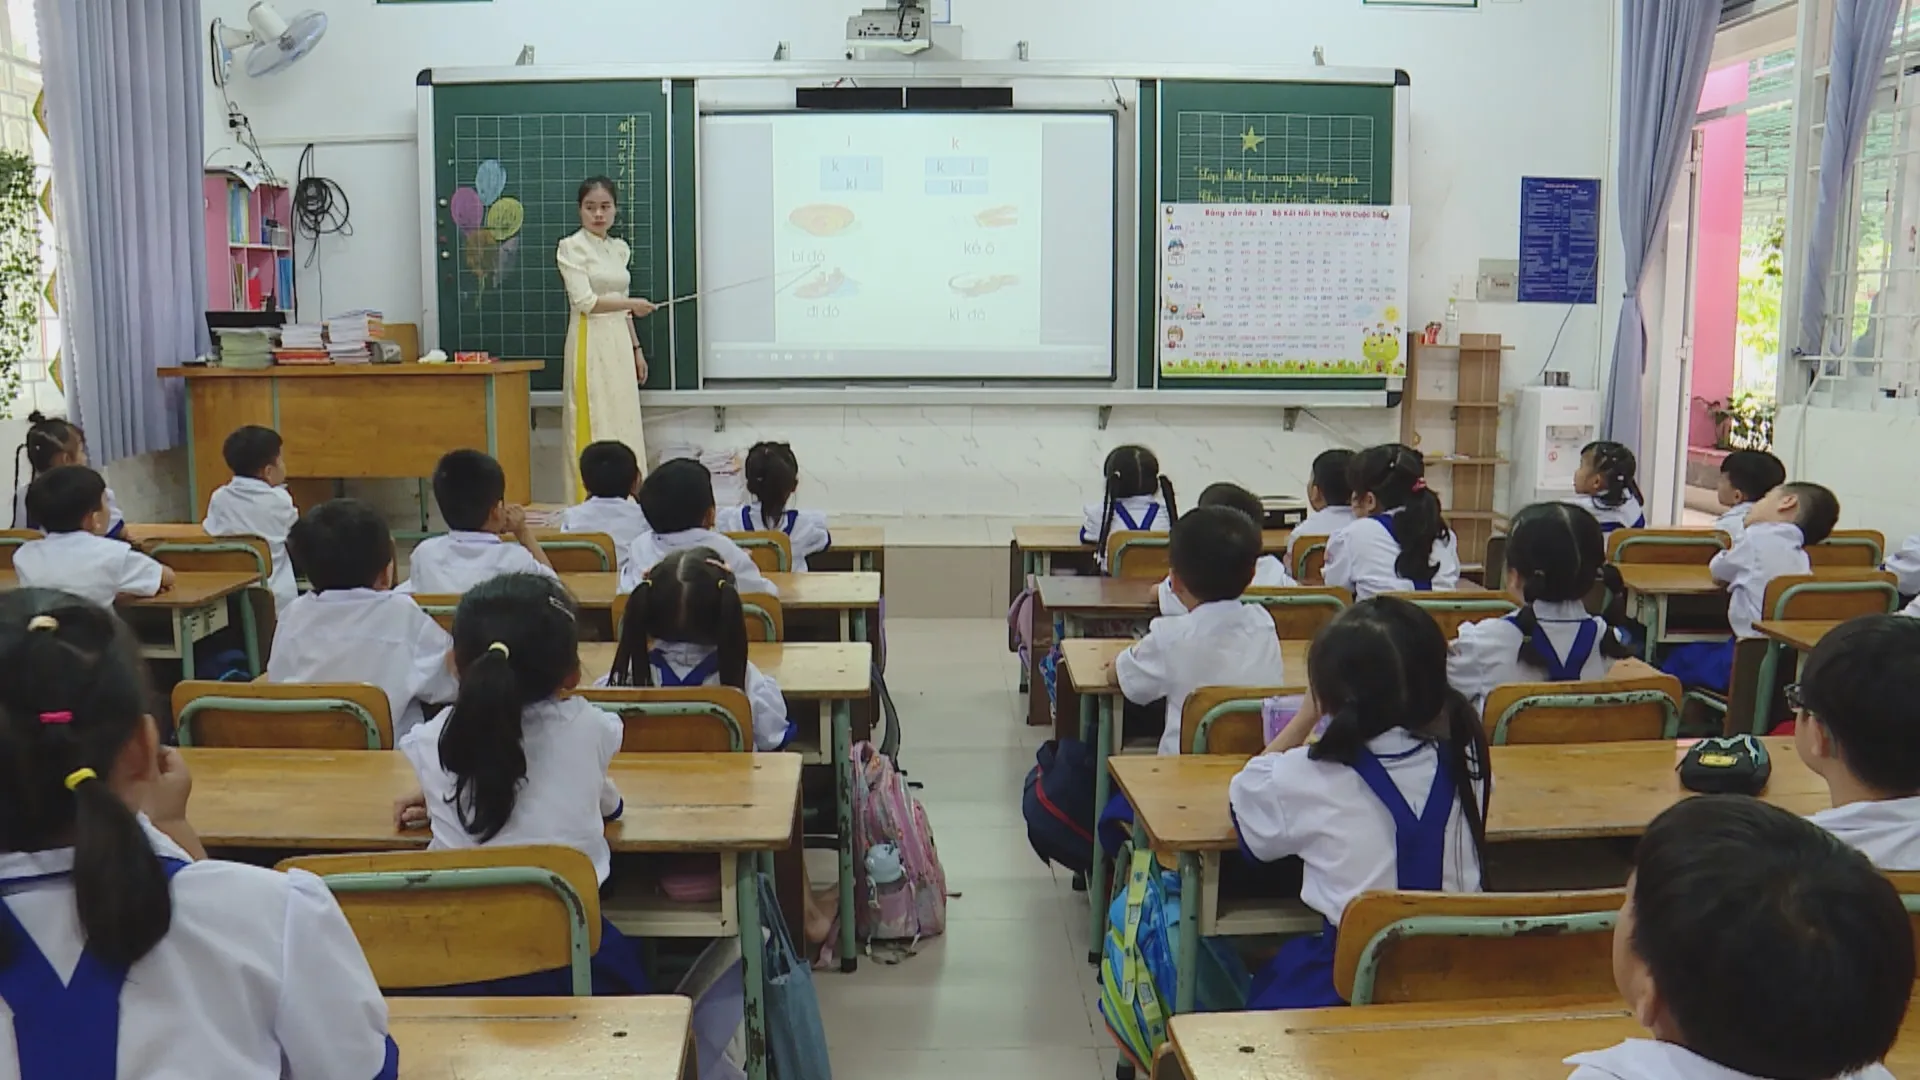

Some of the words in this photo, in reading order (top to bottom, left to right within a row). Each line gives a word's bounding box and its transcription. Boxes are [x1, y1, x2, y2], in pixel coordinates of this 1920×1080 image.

[618, 121, 628, 132] 10
[618, 139, 627, 151] 9
[951, 136, 960, 150] k
[618, 151, 625, 163] 8
[831, 157, 840, 173] k
[936, 159, 945, 174] k
[618, 166, 625, 177] 7
